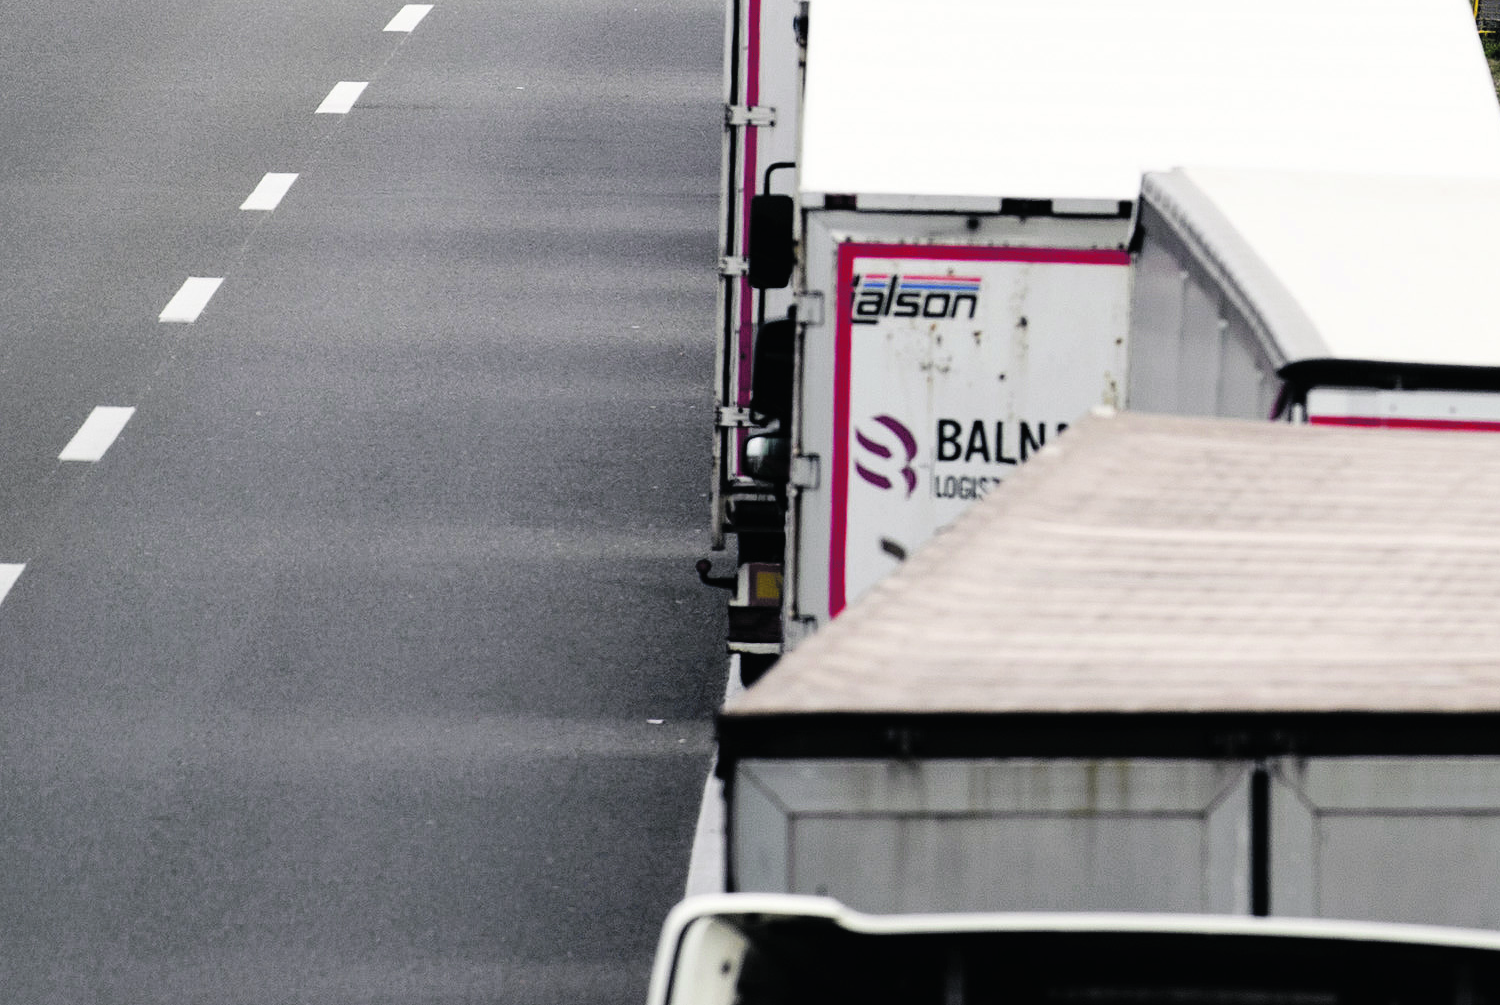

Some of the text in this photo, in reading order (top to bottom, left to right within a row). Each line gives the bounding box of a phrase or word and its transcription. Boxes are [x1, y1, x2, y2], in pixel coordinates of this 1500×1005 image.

[850, 274, 978, 324] alson
[937, 418, 1069, 465] BALN
[935, 474, 1001, 500] LOGIS
